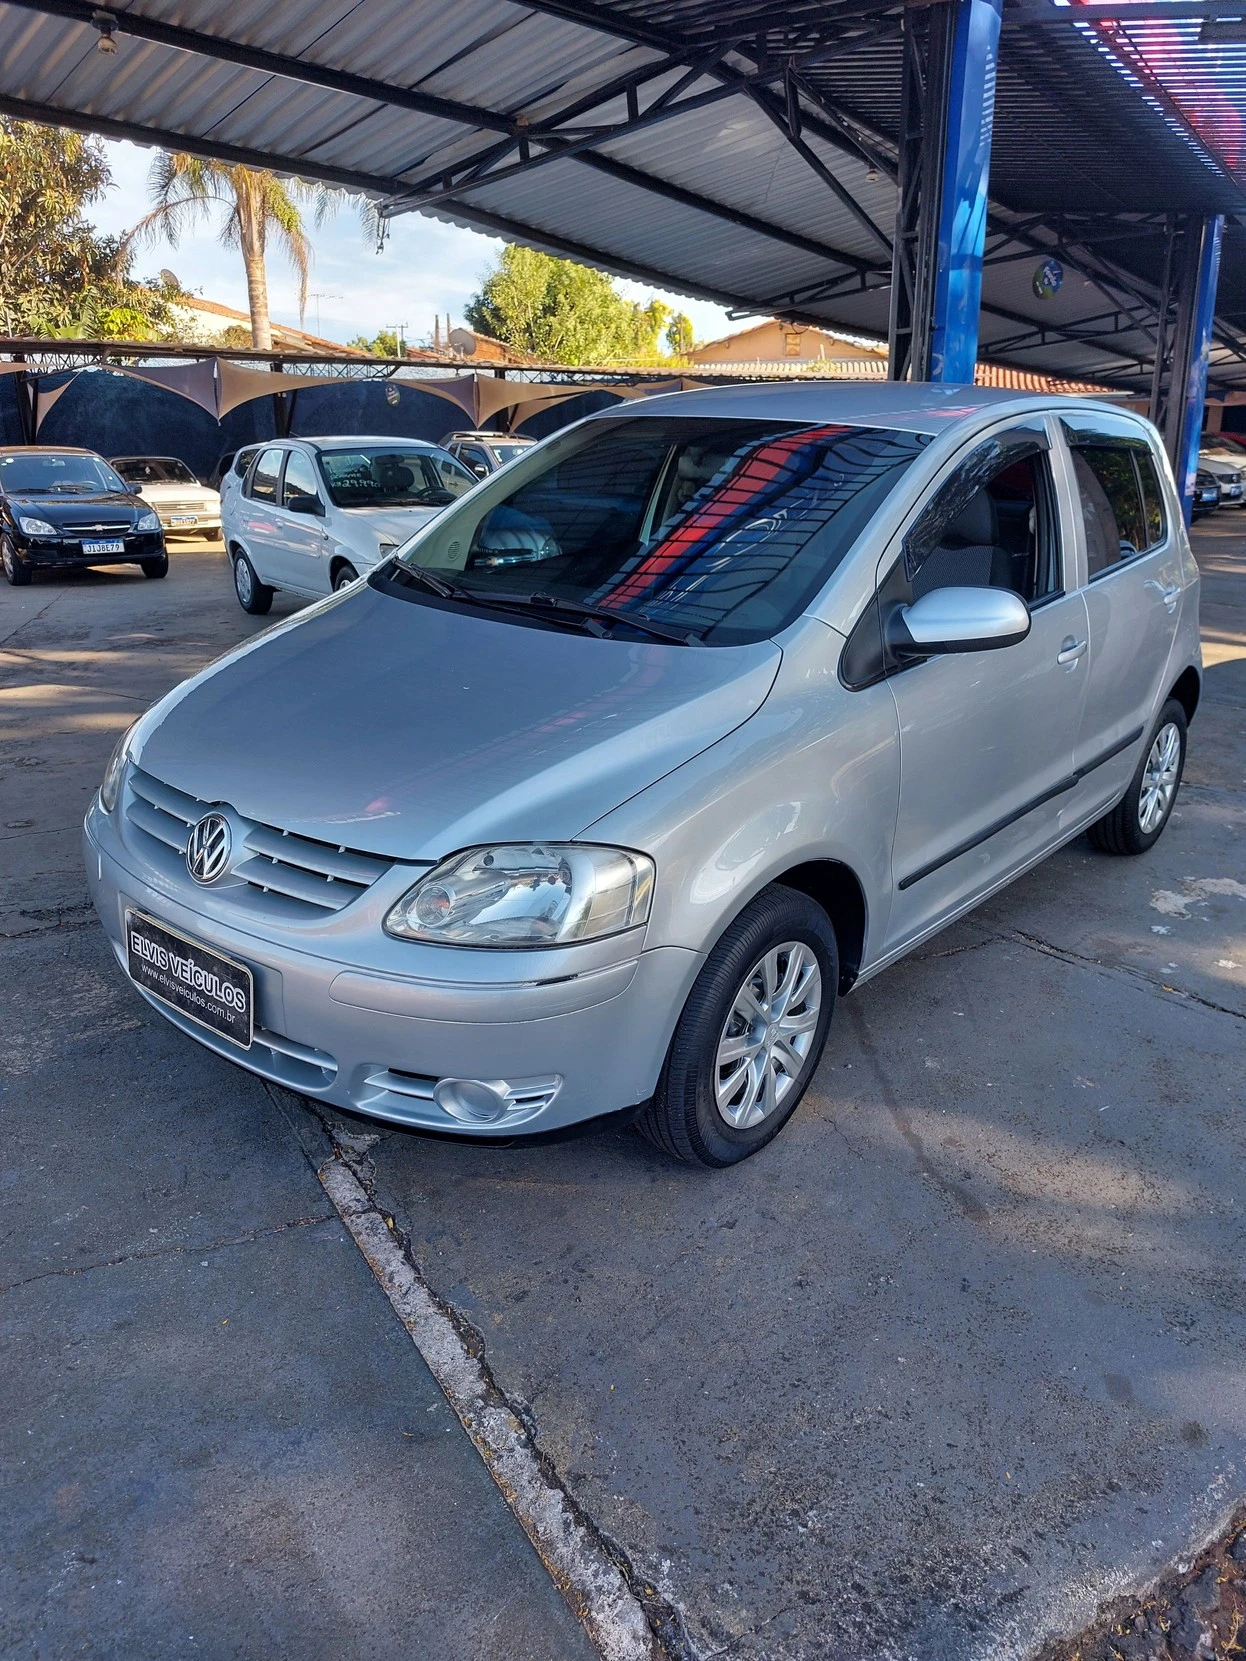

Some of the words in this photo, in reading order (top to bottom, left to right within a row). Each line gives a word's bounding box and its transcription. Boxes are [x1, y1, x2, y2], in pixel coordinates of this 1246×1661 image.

[131, 931, 168, 970] ELVIS
[168, 952, 246, 1013] VEÍCULOS
[141, 963, 236, 1023] www.elvisveiculos.com.br
